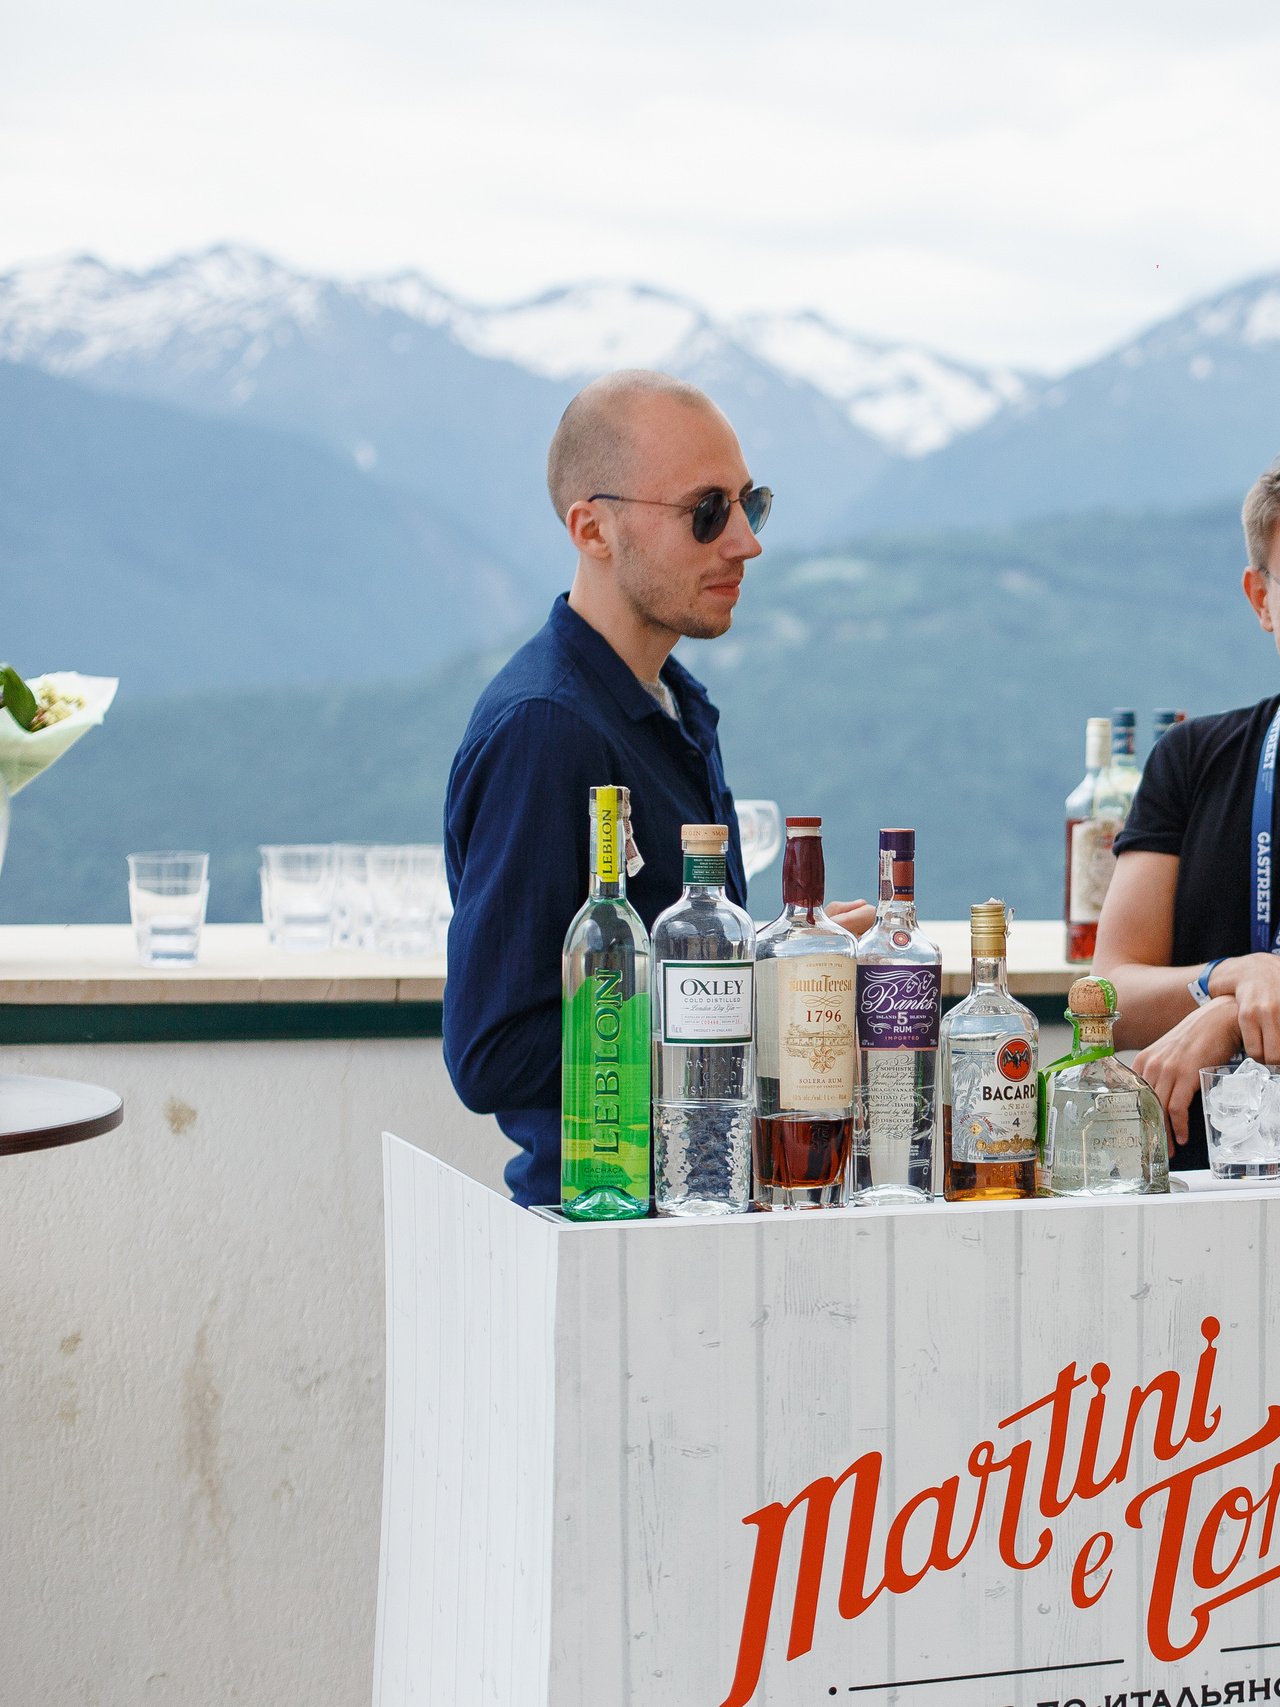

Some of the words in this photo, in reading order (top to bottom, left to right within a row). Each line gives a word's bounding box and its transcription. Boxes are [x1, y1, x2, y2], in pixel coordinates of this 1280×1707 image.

[602, 809, 613, 874] LEBLON
[1257, 831, 1271, 924] GASTREET
[680, 978, 744, 996] OXLEY
[806, 1009, 842, 1023] 1796
[897, 1011, 909, 1026] 5
[893, 1025, 912, 1033] RUM
[591, 967, 623, 1156] LEBLON
[1012, 1117, 1021, 1128] 4
[1093, 1133, 1143, 1150] PATRÓN
[718, 1315, 1222, 1707] Martini
[1071, 1531, 1114, 1609] e
